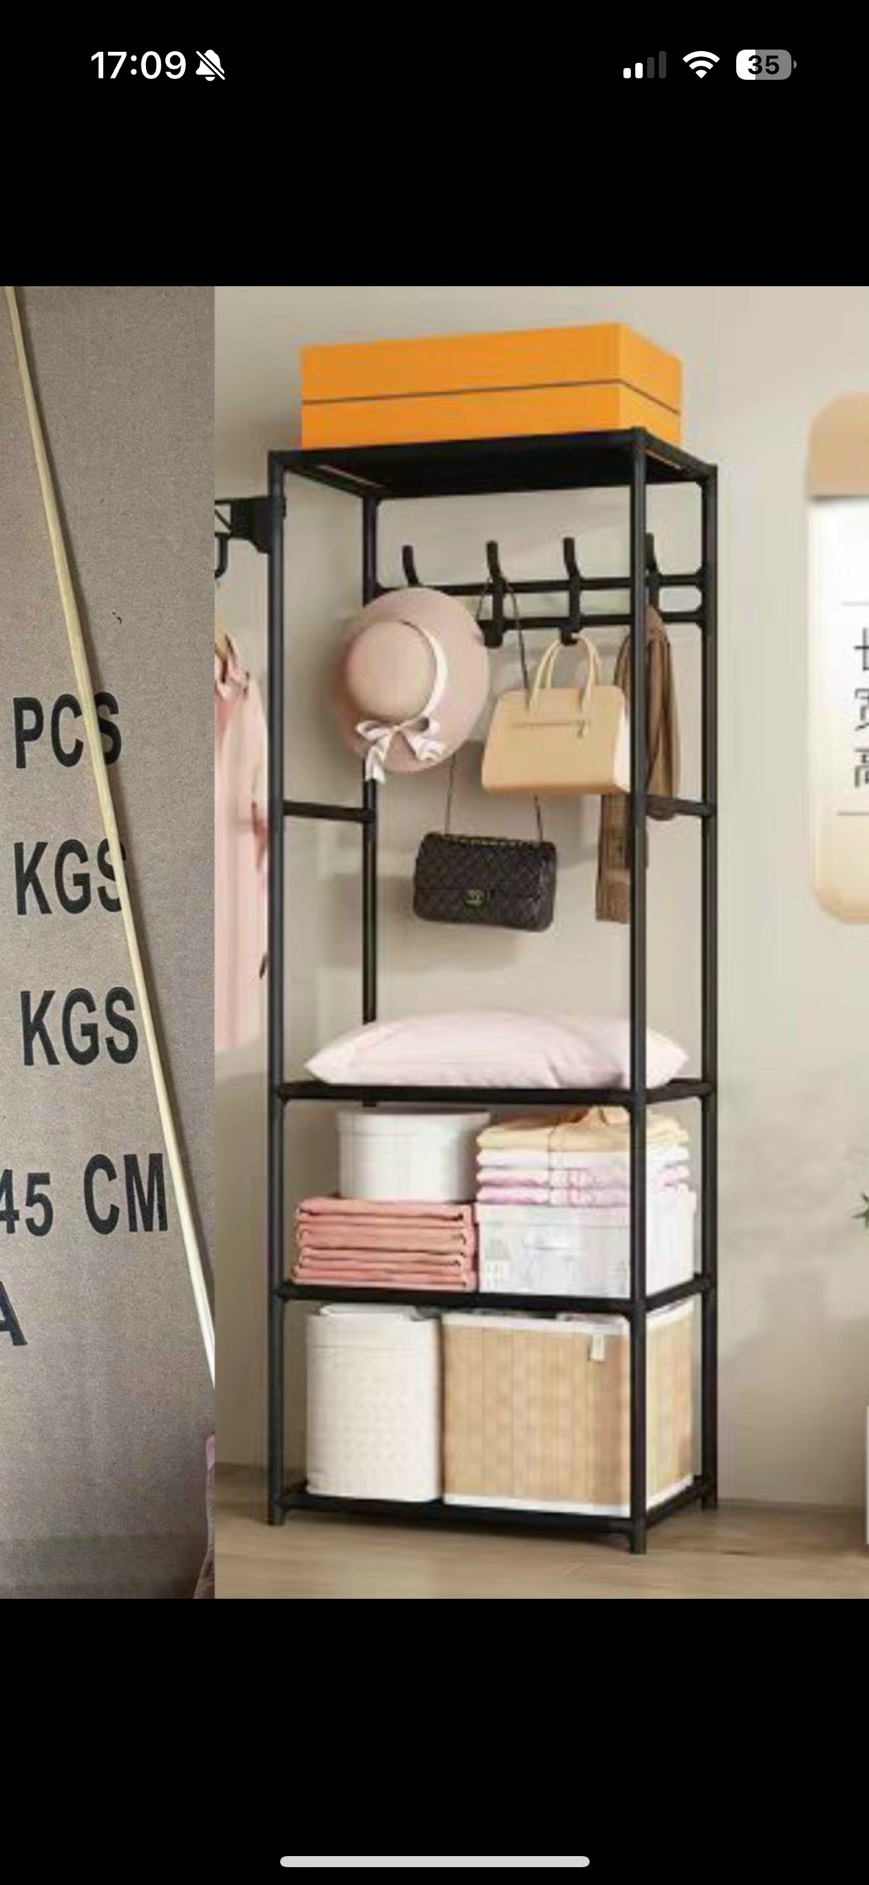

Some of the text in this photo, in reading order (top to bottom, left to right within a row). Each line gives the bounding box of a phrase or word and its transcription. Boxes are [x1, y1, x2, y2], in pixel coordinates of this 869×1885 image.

[90, 50, 187, 80] 17:09
[747, 54, 780, 76] 35
[13, 691, 122, 769] PCS
[14, 837, 128, 915] KGS
[21, 986, 138, 1066] KGS
[84, 1152, 168, 1235] CM
